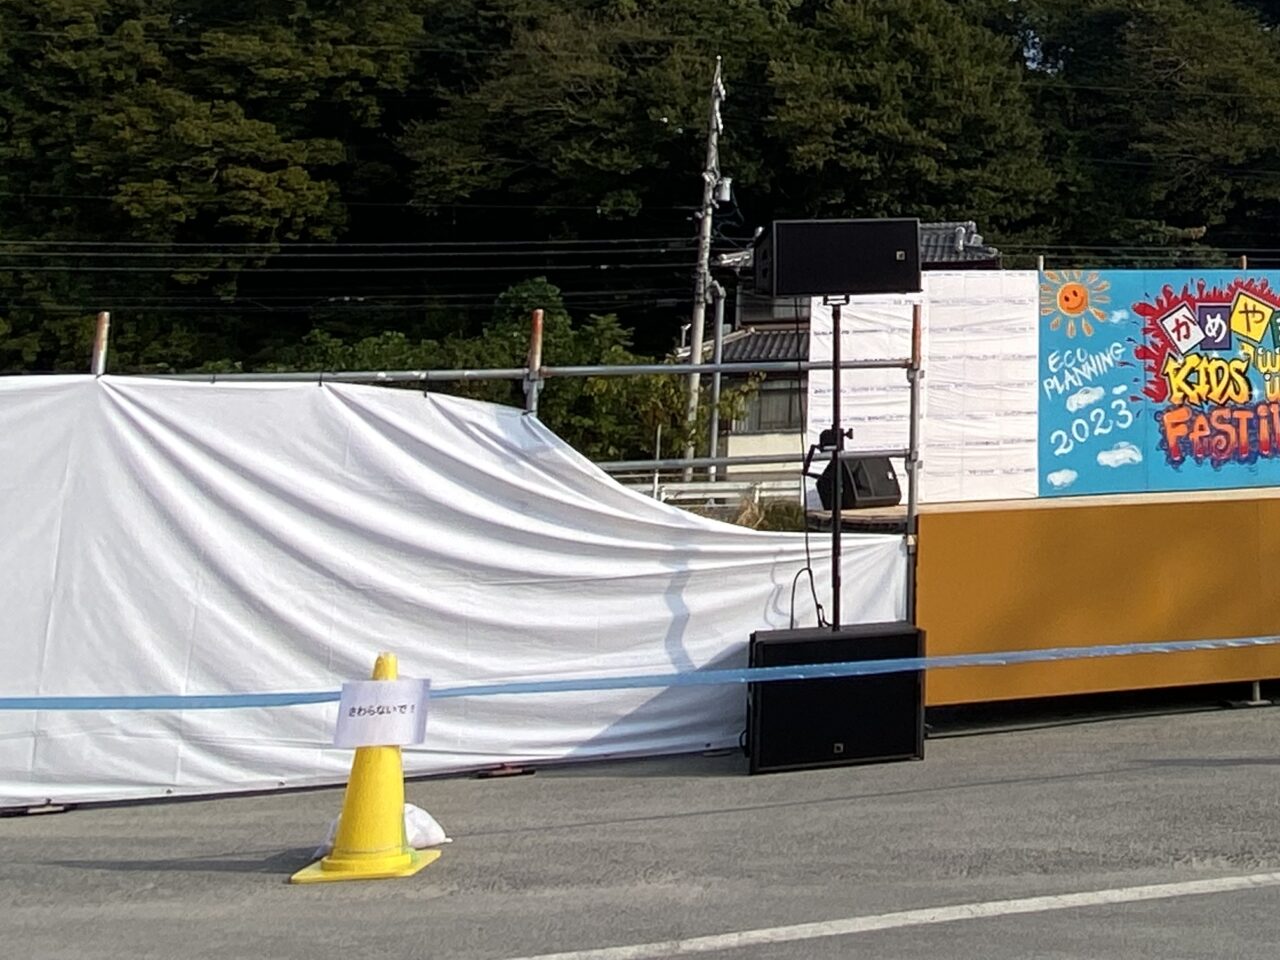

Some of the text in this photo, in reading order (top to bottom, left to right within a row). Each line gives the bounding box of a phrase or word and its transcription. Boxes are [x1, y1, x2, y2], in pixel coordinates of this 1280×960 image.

[1042, 342, 1126, 401] PLANNING
[1047, 347, 1088, 373] ECO
[1162, 353, 1252, 407] KIDS
[1050, 399, 1133, 456] 2023
